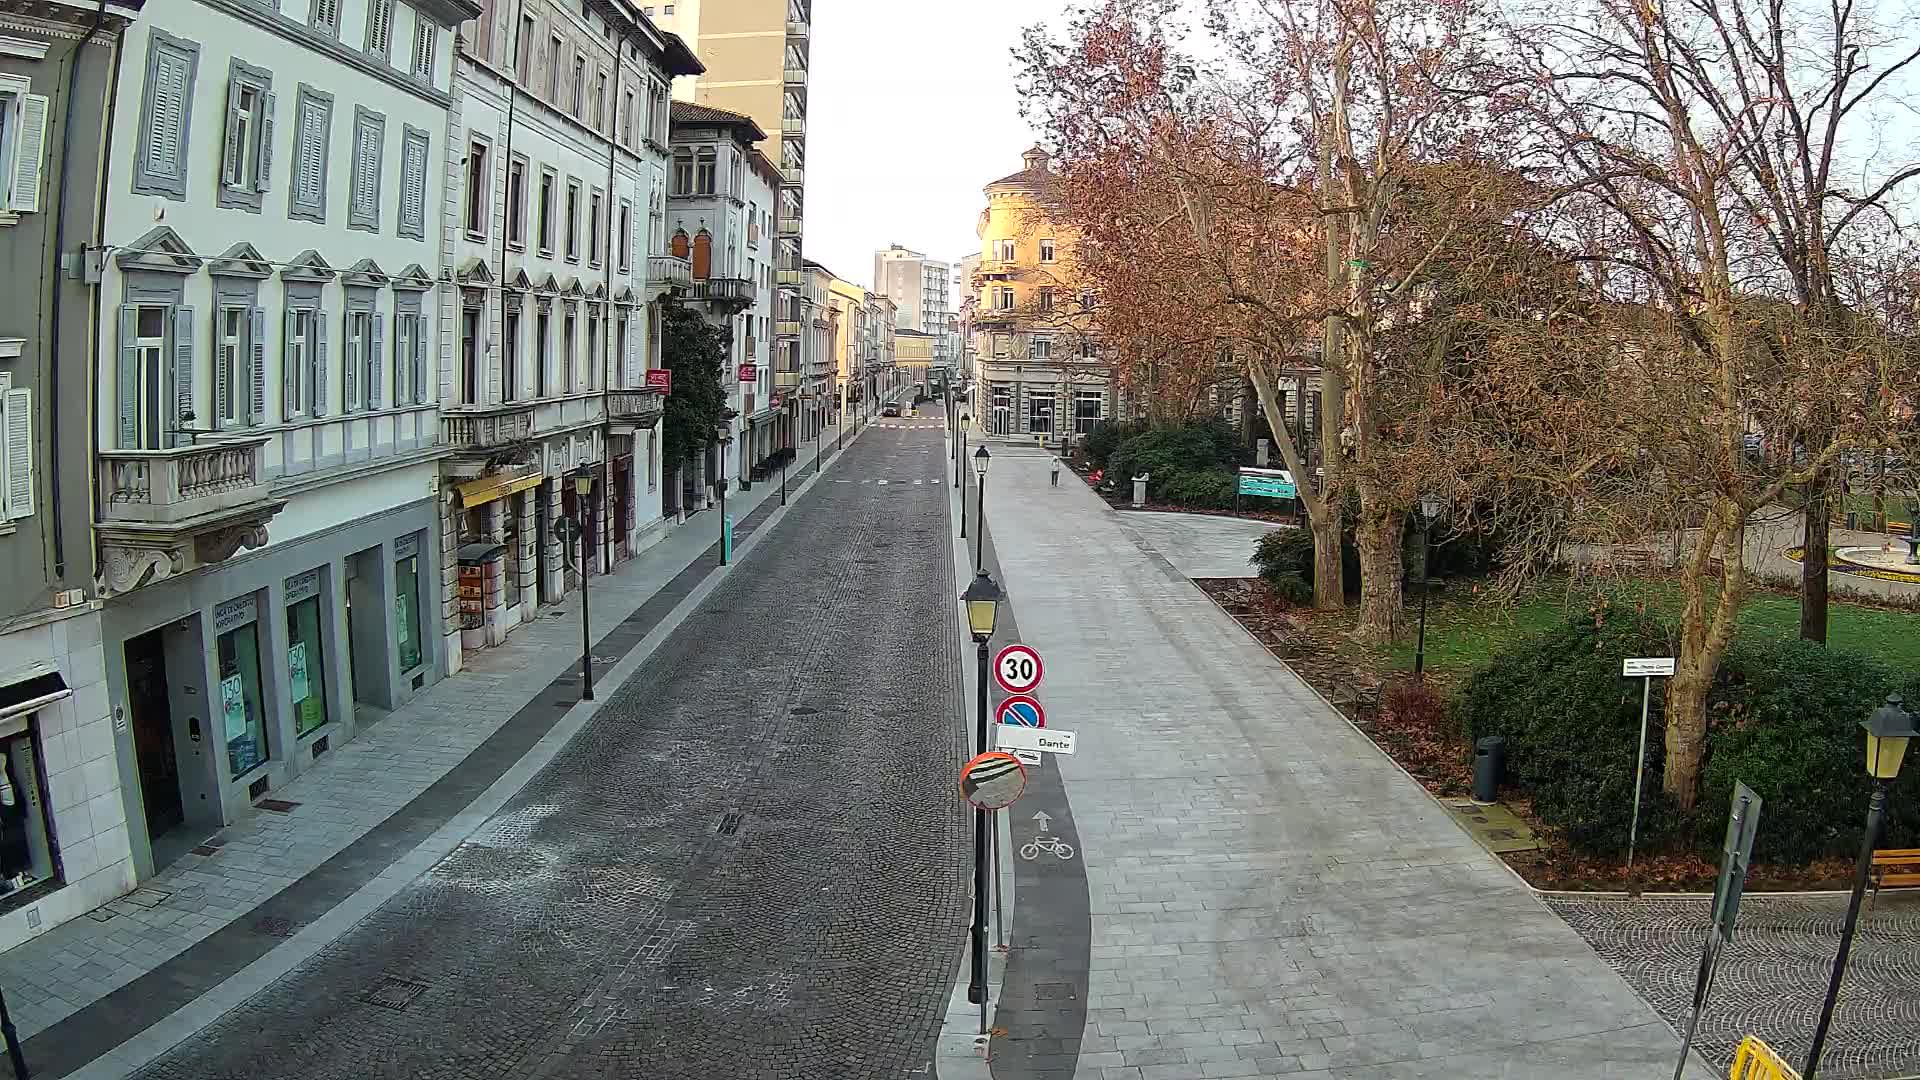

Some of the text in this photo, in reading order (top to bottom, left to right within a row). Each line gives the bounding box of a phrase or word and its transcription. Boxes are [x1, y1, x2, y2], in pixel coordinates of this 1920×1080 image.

[1005, 658, 1033, 681] 30
[223, 677, 241, 700] 130
[1039, 738, 1070, 748] Dante
